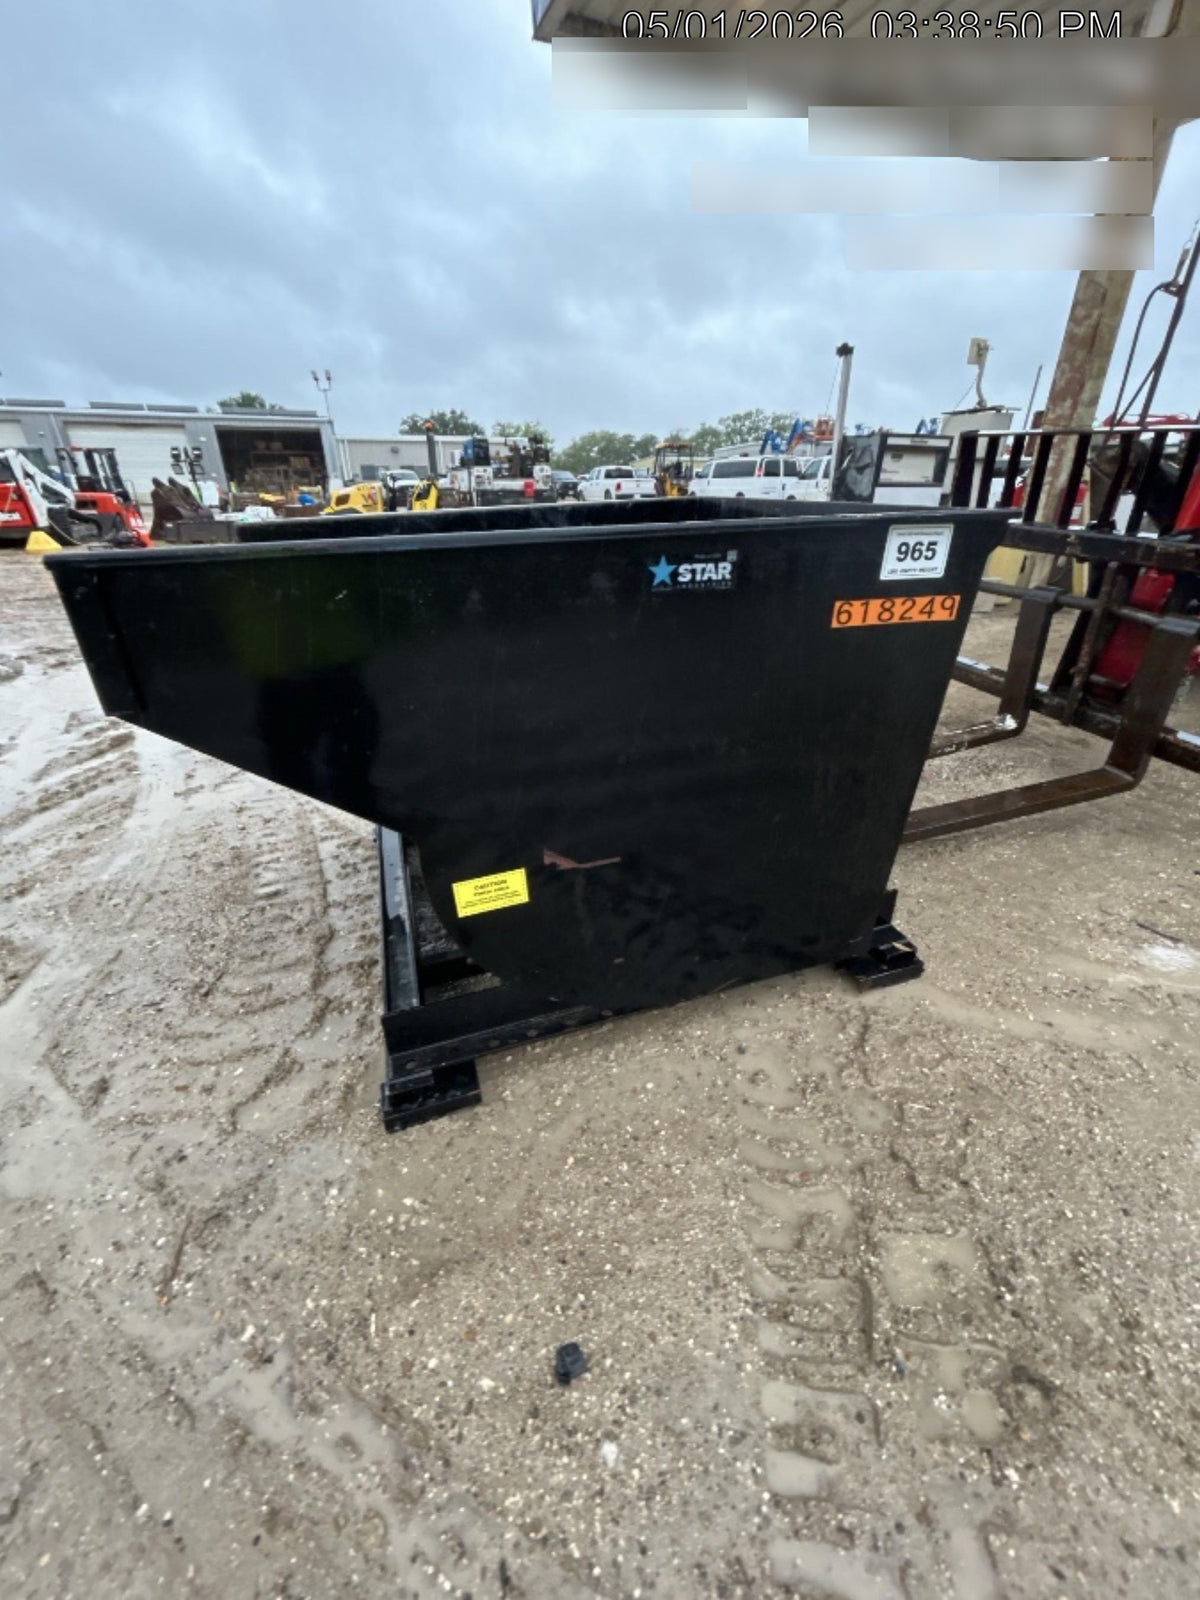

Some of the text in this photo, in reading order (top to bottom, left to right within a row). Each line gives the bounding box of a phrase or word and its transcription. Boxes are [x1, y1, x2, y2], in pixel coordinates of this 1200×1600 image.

[896, 540, 938, 562] 965
[677, 562, 732, 582] STAR
[836, 596, 956, 625] 618249
